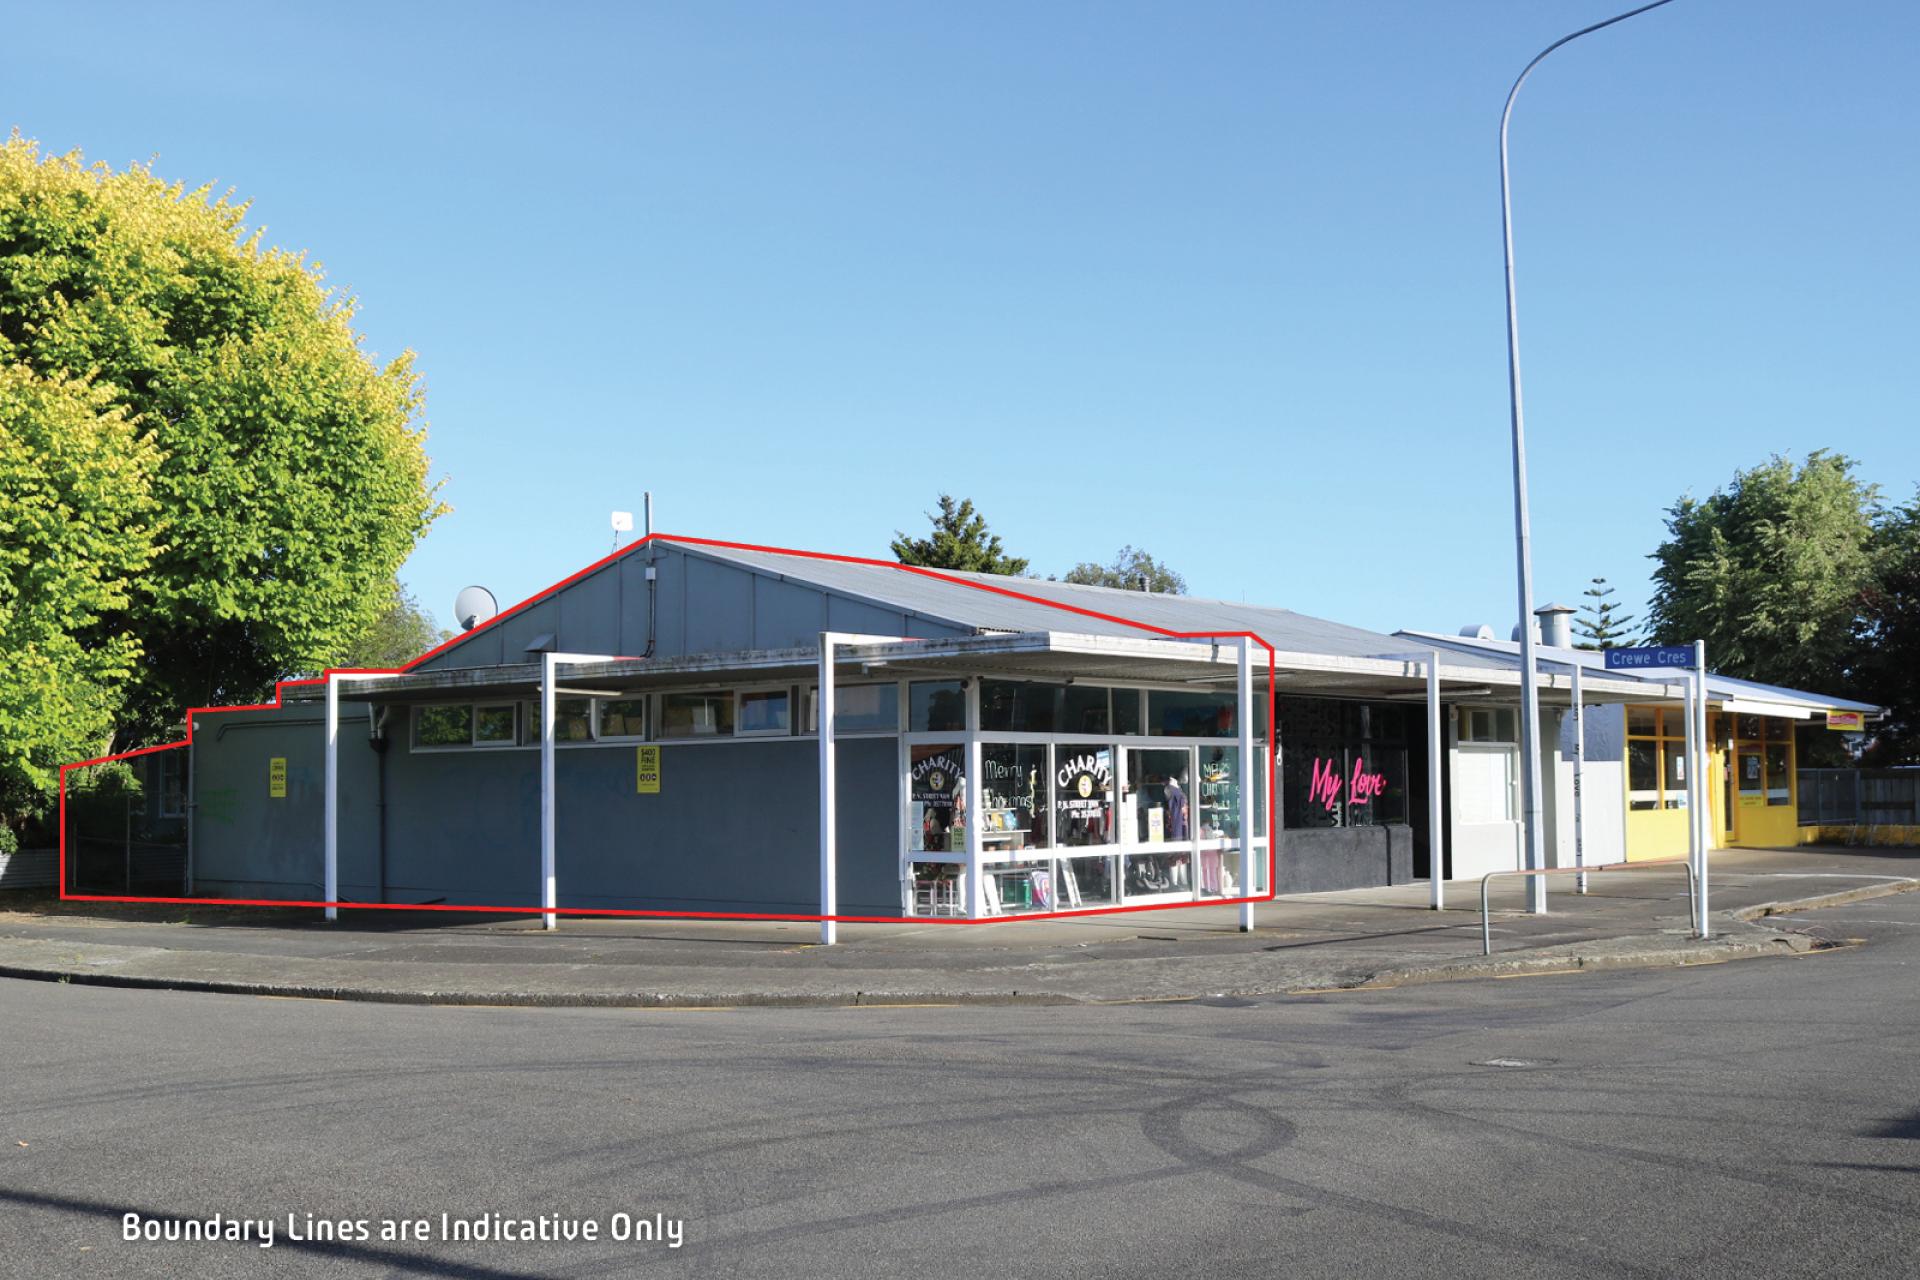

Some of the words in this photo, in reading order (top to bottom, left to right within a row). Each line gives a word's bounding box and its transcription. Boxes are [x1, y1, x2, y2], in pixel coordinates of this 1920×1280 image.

[1612, 652, 1650, 665] Crewe
[1657, 651, 1686, 664] Cres
[911, 755, 965, 781] CHARITY
[984, 759, 1023, 788] Merry
[1057, 754, 1113, 787] CHARITY
[1309, 757, 1343, 811] My
[1349, 757, 1387, 805] Love
